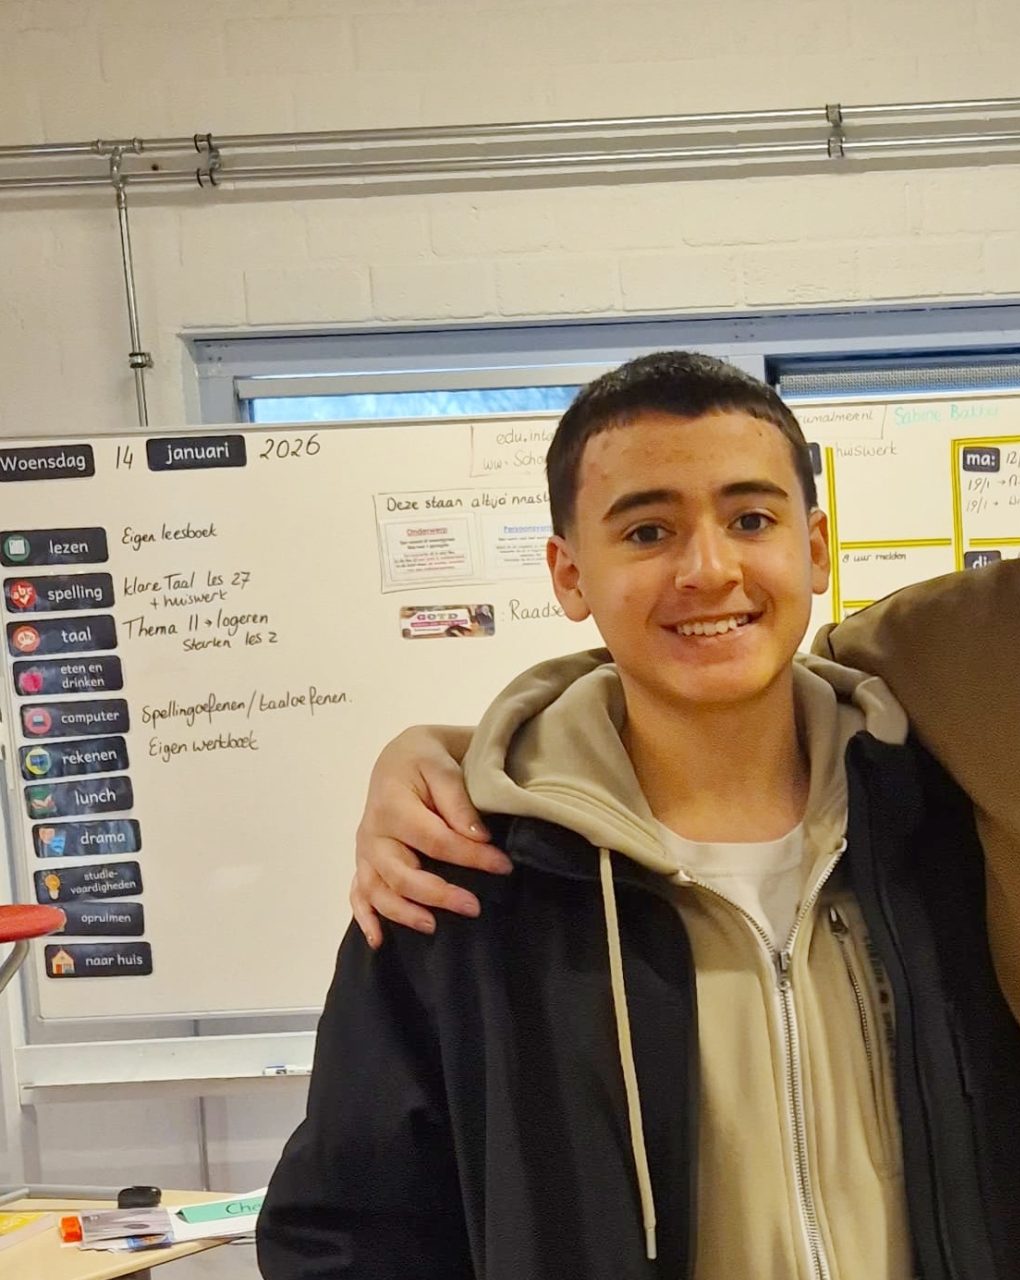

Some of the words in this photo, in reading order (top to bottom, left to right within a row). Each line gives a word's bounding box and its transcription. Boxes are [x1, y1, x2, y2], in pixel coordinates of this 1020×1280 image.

[165, 442, 231, 465] januari
[259, 434, 321, 460] 2026
[1, 453, 87, 471] Woensdag
[115, 445, 134, 470] 14
[513, 449, 545, 467] Scho
[966, 453, 996, 466] ma:
[387, 496, 419, 512] Deze
[425, 495, 463, 509] staan
[121, 527, 156, 551] Eigen
[161, 522, 218, 541] leesboek
[49, 539, 89, 555] lezen
[163, 571, 195, 591] Taal
[231, 571, 251, 589] 27
[47, 584, 103, 603] spelling
[163, 589, 228, 608] huiswerk
[508, 598, 565, 621] Raadse
[122, 615, 178, 640] Thema
[216, 608, 269, 637] logeren
[61, 626, 92, 643] taal
[245, 631, 263, 646] les
[268, 631, 278, 643] 2
[60, 664, 86, 675] eten
[88, 664, 103, 674] en
[61, 676, 105, 689] drinken
[61, 710, 120, 726] computer
[62, 749, 118, 765] rekenen
[149, 736, 188, 763] Eigen
[75, 788, 117, 806] lunch
[80, 831, 126, 846] drama
[83, 869, 118, 881] studie-
[70, 880, 136, 895] vaardigheden
[81, 912, 132, 925] opruimen
[85, 956, 115, 966] naar
[117, 953, 143, 966] huis
